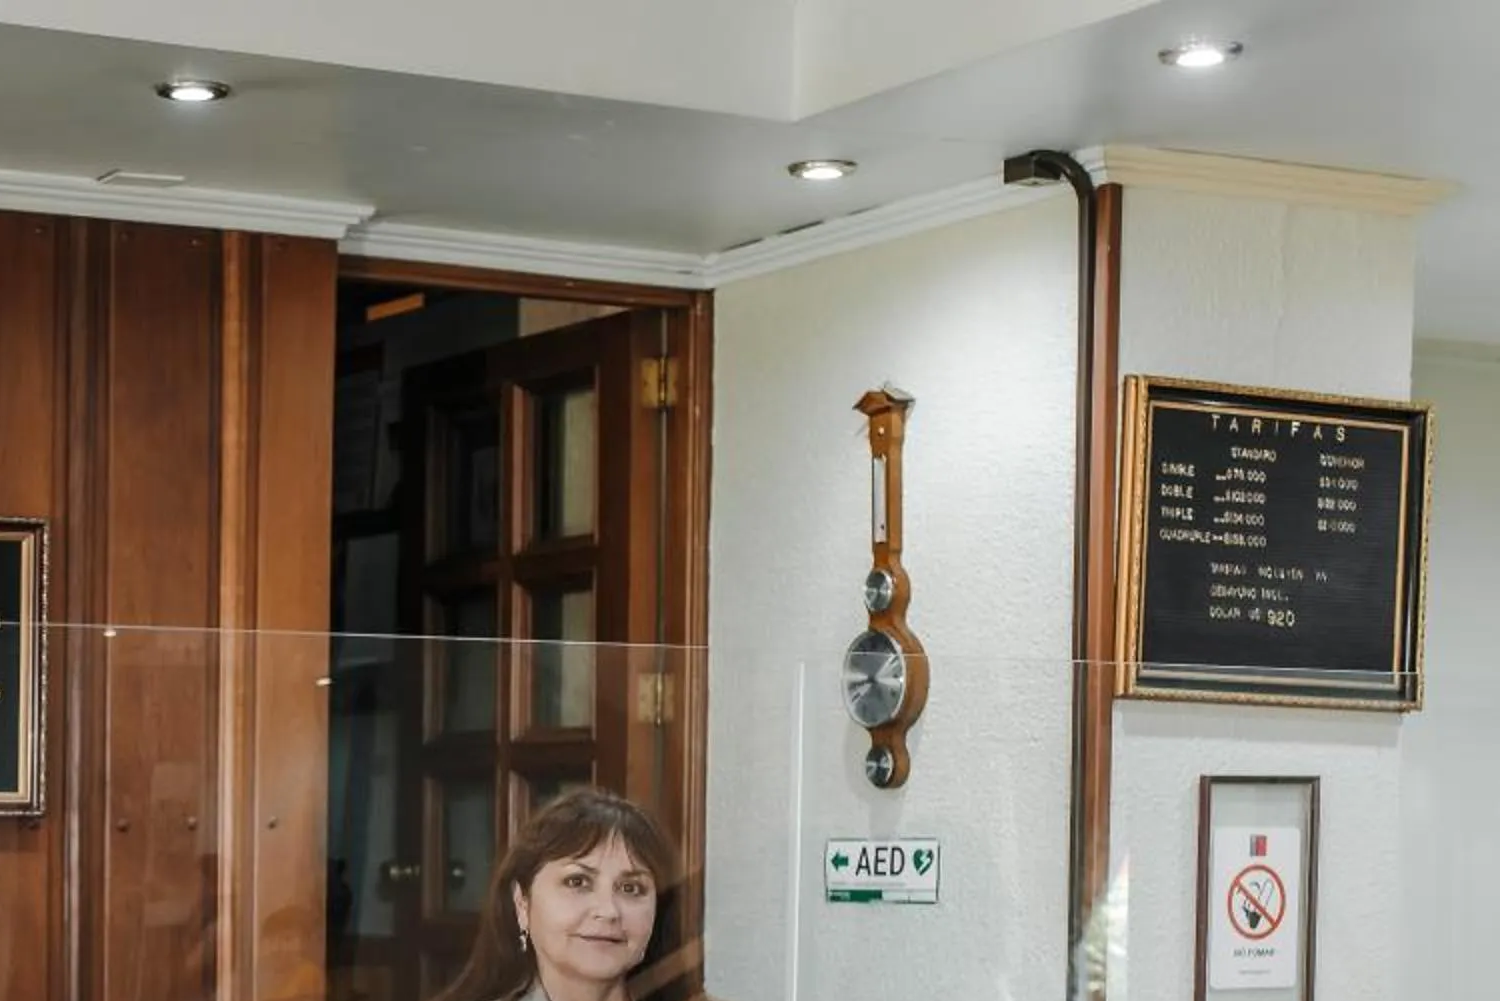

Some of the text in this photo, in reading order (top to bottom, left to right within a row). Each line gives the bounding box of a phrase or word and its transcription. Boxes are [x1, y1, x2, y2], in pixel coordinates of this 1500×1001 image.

[1211, 414, 1347, 443] TARIFAS
[1267, 609, 1296, 627] 920
[854, 846, 906, 876] AED
